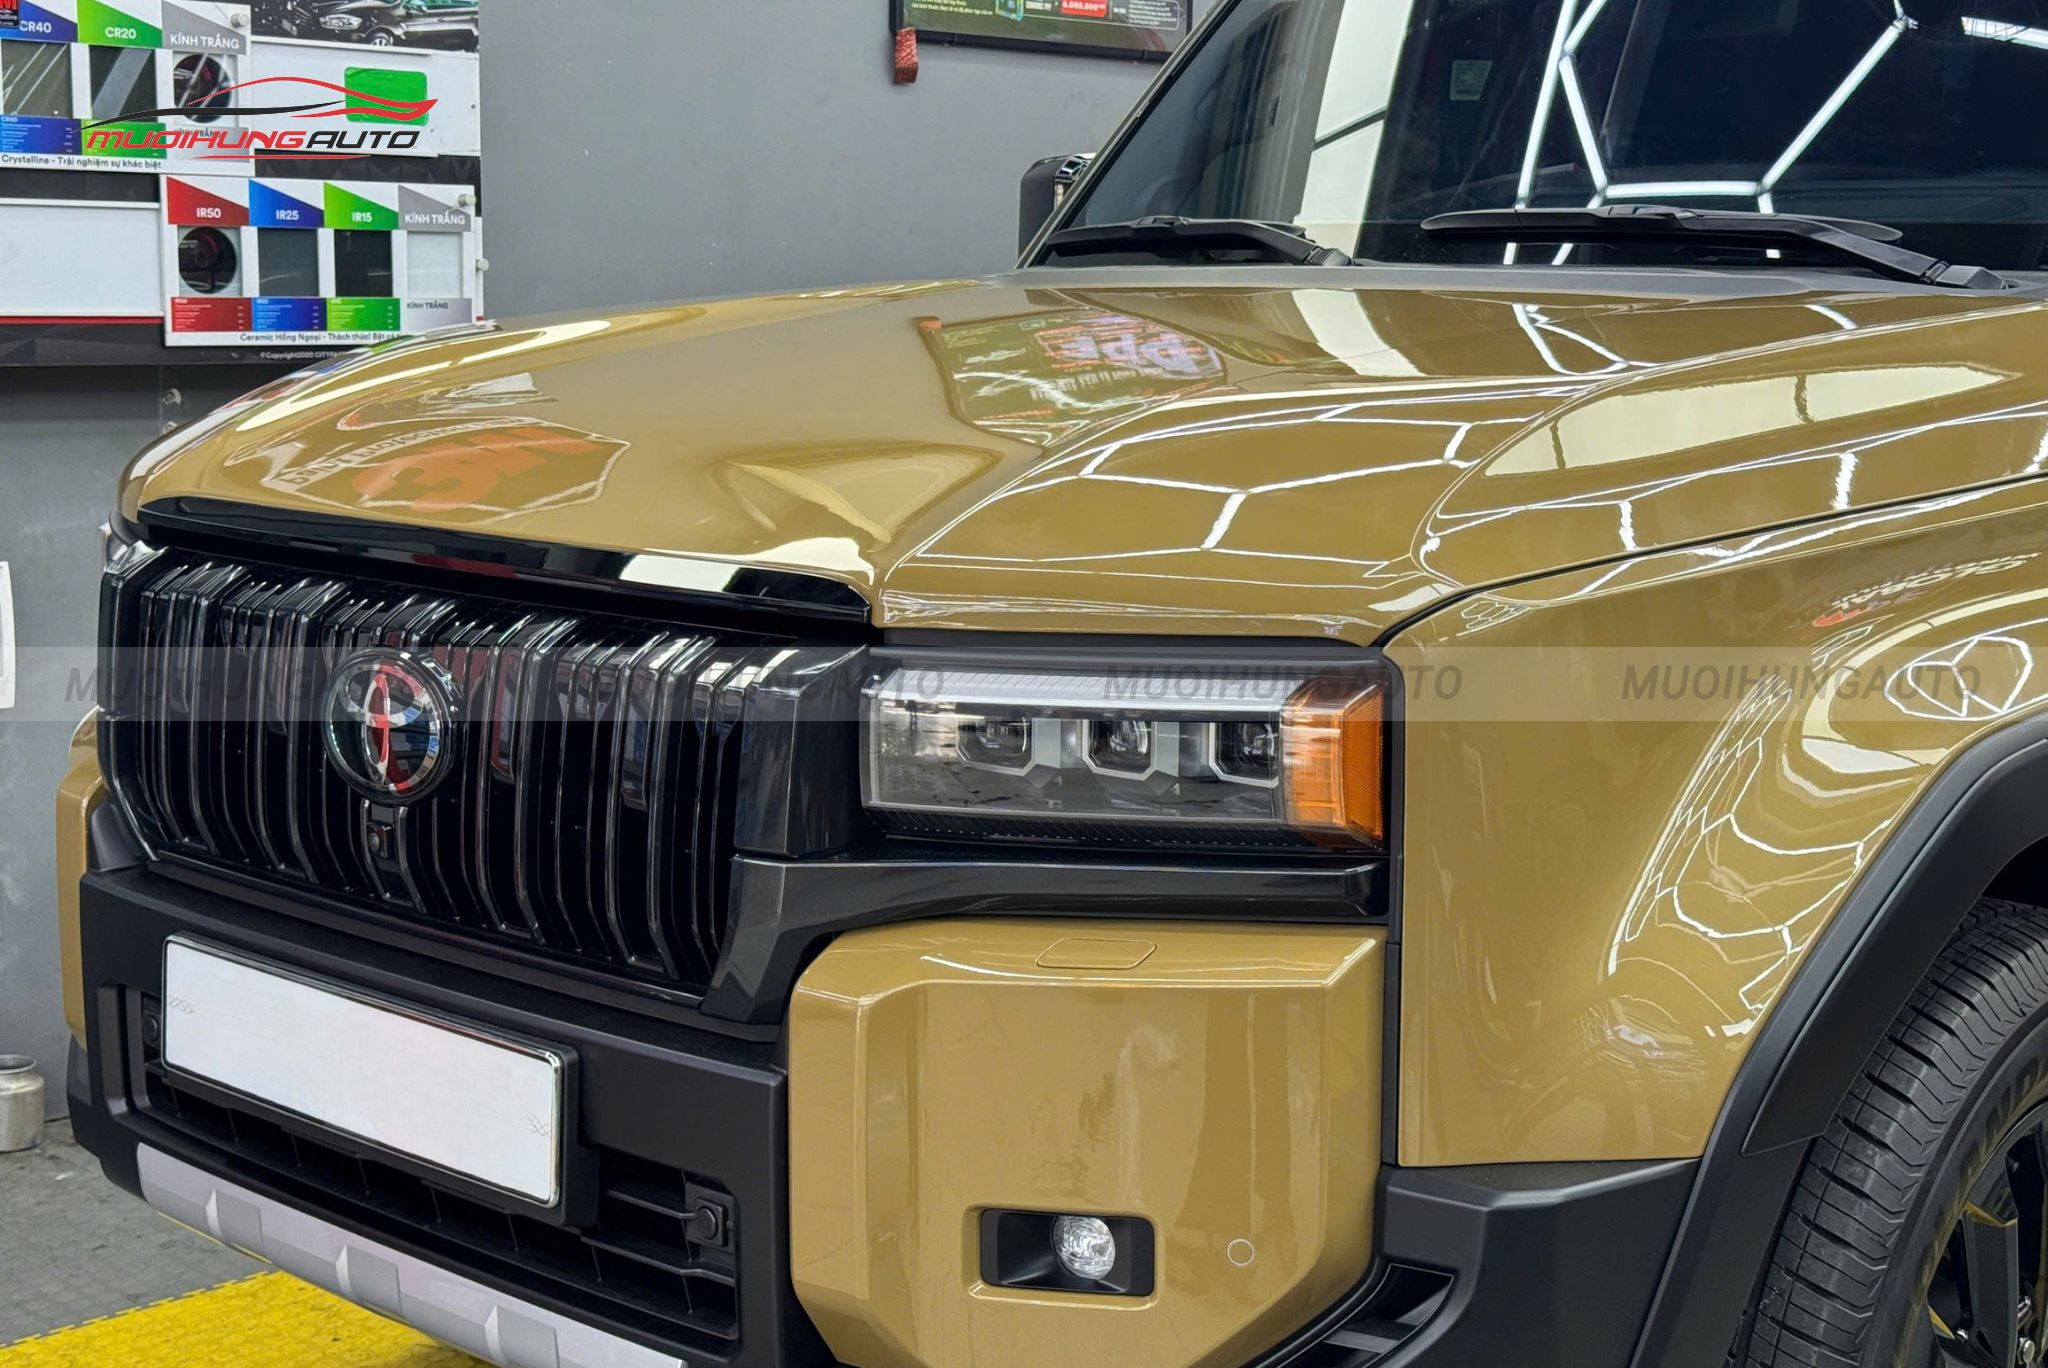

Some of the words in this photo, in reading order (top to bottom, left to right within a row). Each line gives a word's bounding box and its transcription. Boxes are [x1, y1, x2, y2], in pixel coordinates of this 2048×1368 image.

[19, 20, 52, 34] CR40
[105, 27, 136, 40] CR20
[169, 33, 198, 47] KÍNH
[200, 34, 240, 50] TRẮNG
[1, 154, 50, 168] Crystalline
[58, 155, 75, 166] Trải
[76, 156, 109, 170] nghiệm
[123, 158, 142, 168] khác
[143, 159, 162, 170] biệt
[196, 207, 222, 219] IR50
[276, 210, 300, 221] IR25
[352, 212, 372, 223] IR15
[405, 212, 430, 225] KÍNH
[431, 208, 466, 226] TRẮNG
[240, 333, 273, 342] Ceramic
[276, 332, 297, 344] Hồng
[328, 333, 350, 341] Thách
